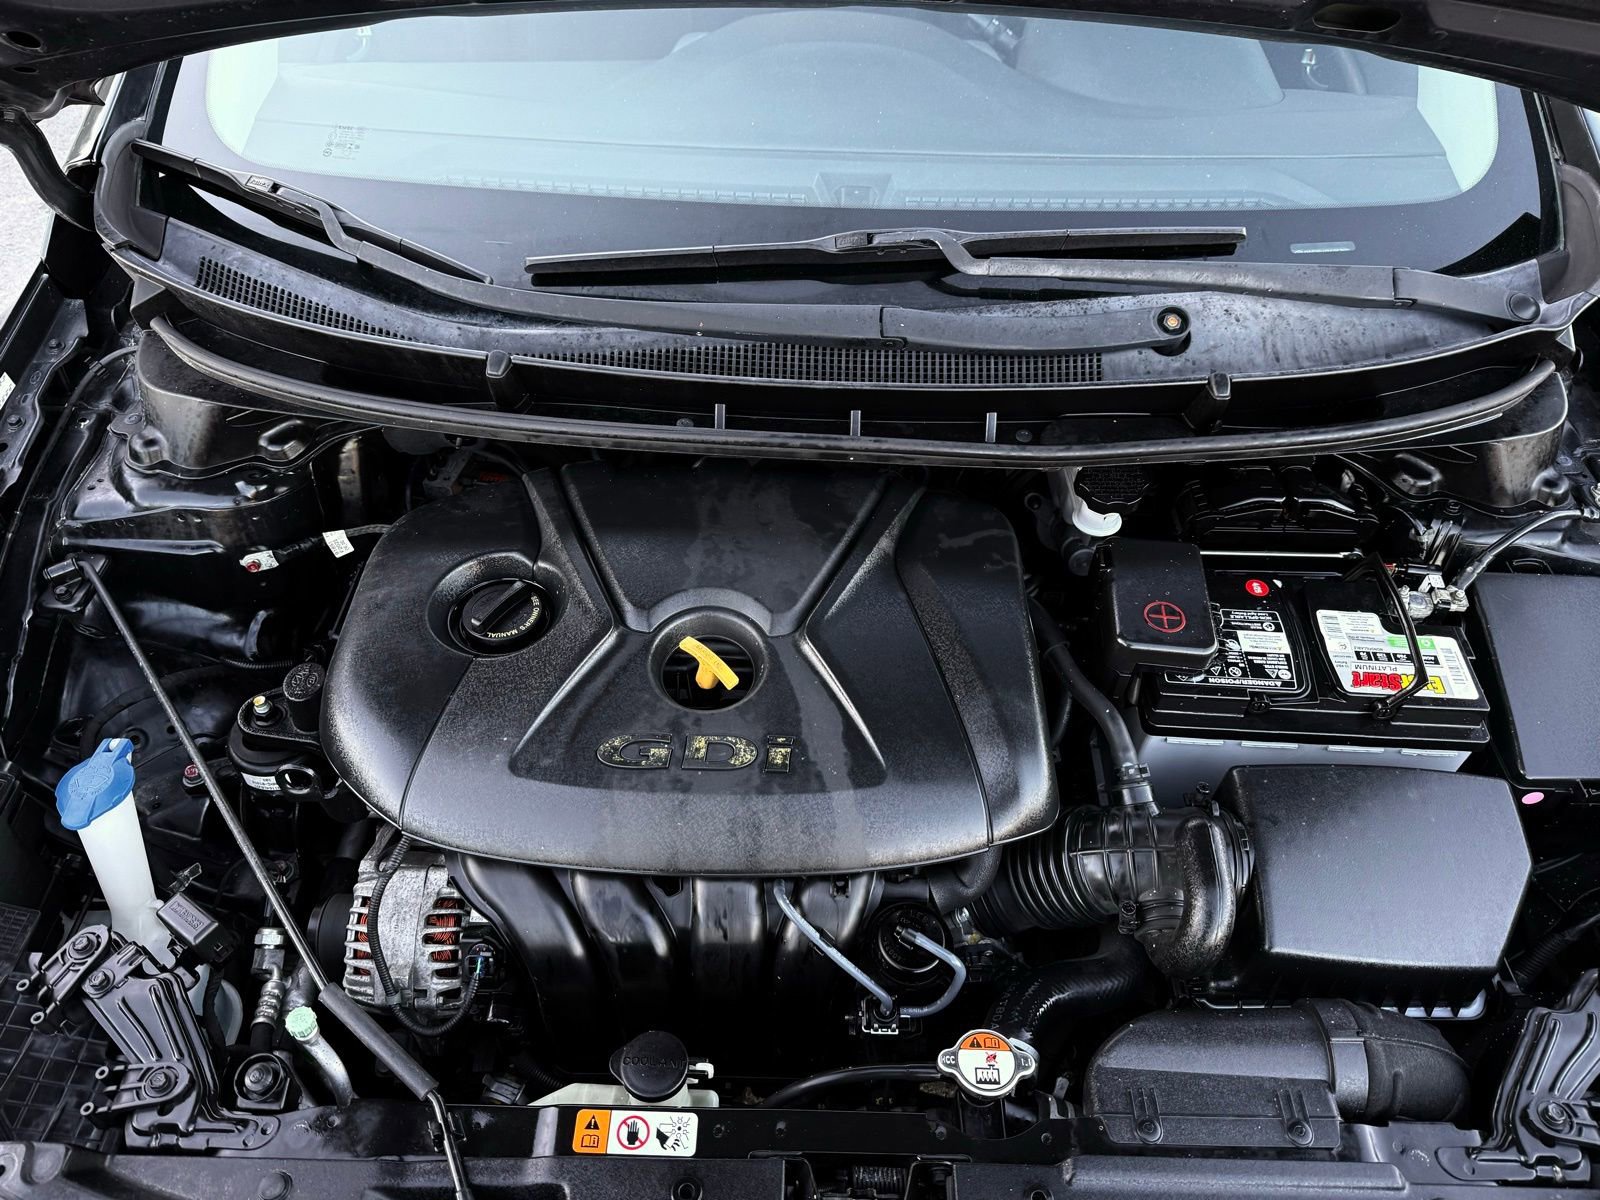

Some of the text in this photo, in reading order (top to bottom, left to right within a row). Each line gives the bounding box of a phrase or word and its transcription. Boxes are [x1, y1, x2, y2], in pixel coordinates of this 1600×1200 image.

[531, 595, 540, 606] SEE
[487, 628, 518, 638] MANUAL
[1354, 664, 1398, 672] PLATINUM
[596, 733, 794, 773] GDi
[622, 1055, 687, 1070] COOLANT
